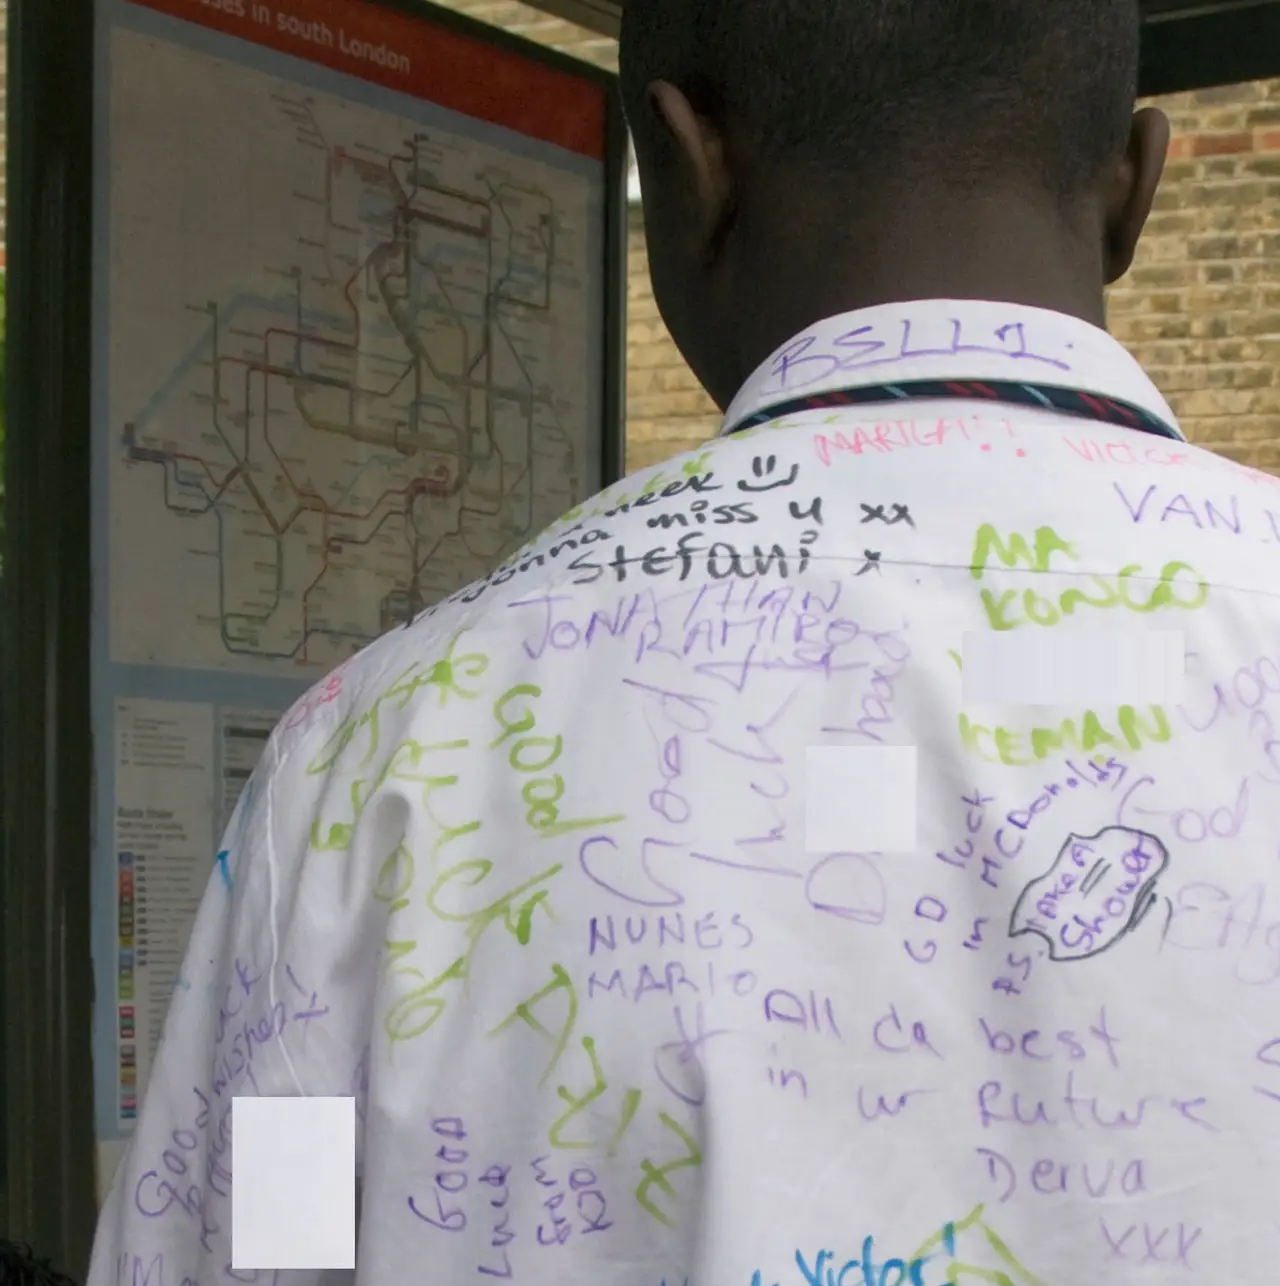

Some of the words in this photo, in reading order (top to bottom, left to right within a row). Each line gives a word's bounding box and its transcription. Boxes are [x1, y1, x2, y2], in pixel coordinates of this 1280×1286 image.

[252, 4, 270, 25] in
[276, 12, 334, 48] south
[339, 28, 411, 74] London
[646, 496, 761, 530] miss
[567, 530, 821, 586] Stefani
[588, 911, 754, 957] NUNES
[586, 959, 758, 1003] MARIO
